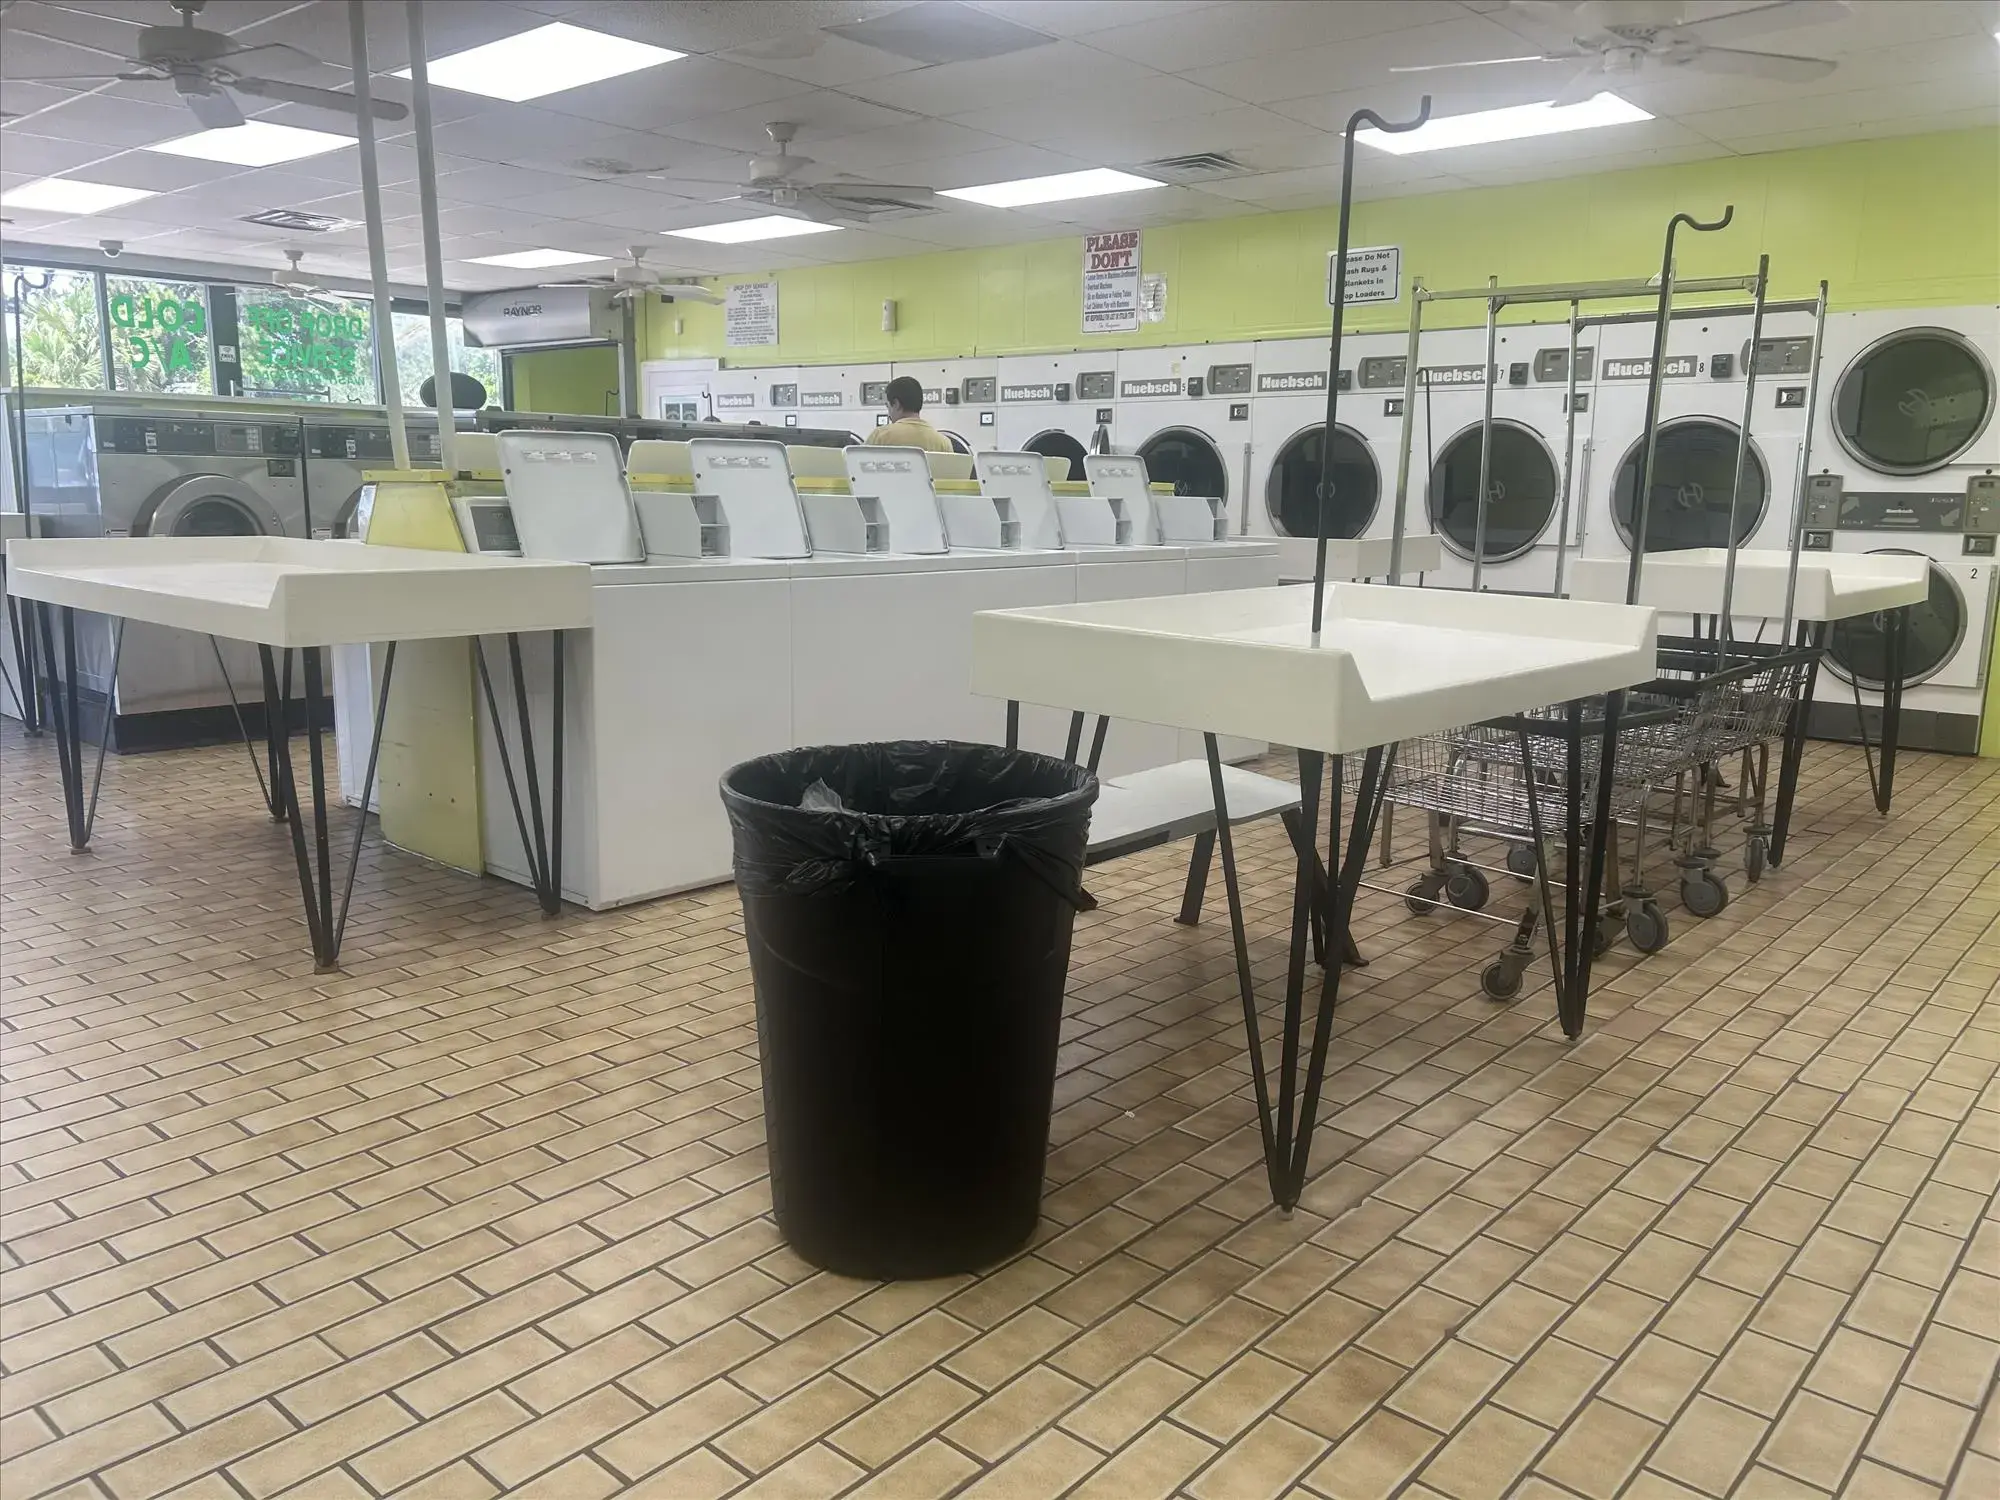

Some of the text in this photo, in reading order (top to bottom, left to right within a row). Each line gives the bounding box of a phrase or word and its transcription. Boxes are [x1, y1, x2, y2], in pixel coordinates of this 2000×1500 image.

[1087, 232, 1138, 253] PLEASE
[1091, 250, 1132, 269] DON'T
[1377, 252, 1390, 260] Not
[1361, 266, 1379, 274] Rugs
[1356, 290, 1385, 298] Loaders
[503, 304, 542, 317] RAYNOR
[1698, 362, 1704, 373] 8
[1125, 380, 1177, 395] Huebsch
[1261, 374, 1323, 389] Huebsch
[1004, 386, 1050, 399] Huebsch
[803, 394, 840, 405] Huebsch
[1970, 567, 1978, 579] 2
